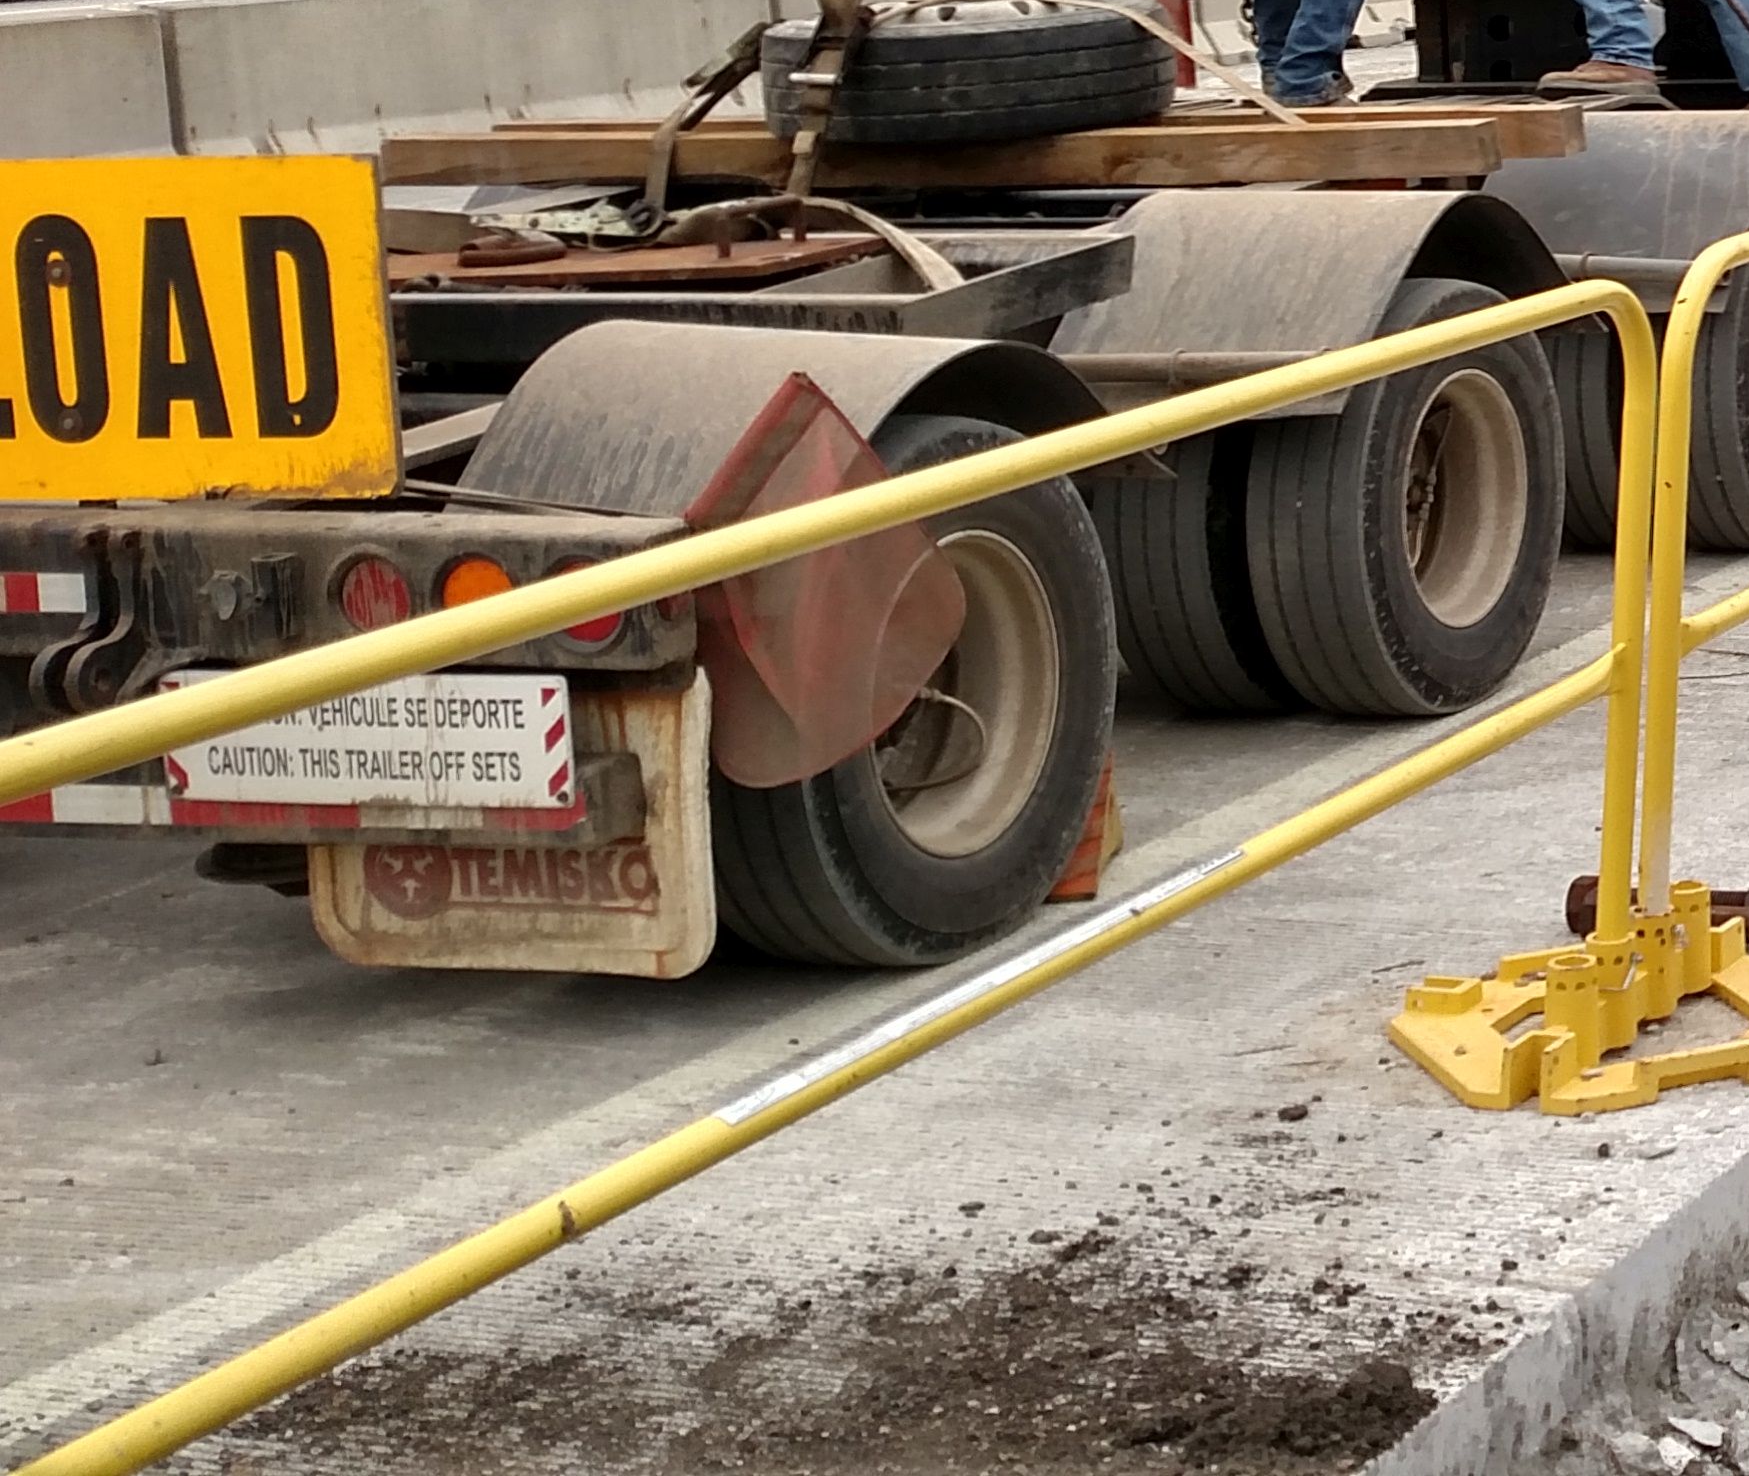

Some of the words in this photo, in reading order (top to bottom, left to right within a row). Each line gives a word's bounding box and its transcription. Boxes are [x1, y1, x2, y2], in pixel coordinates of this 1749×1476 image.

[0, 213, 340, 444] OAD
[404, 698, 429, 728] SE
[208, 745, 295, 777] CAUTION:
[299, 748, 340, 779] THIS
[345, 749, 425, 781] TRAILER
[429, 751, 466, 781] OFF
[471, 752, 523, 782] SETS
[451, 846, 658, 901] TEMISKO
